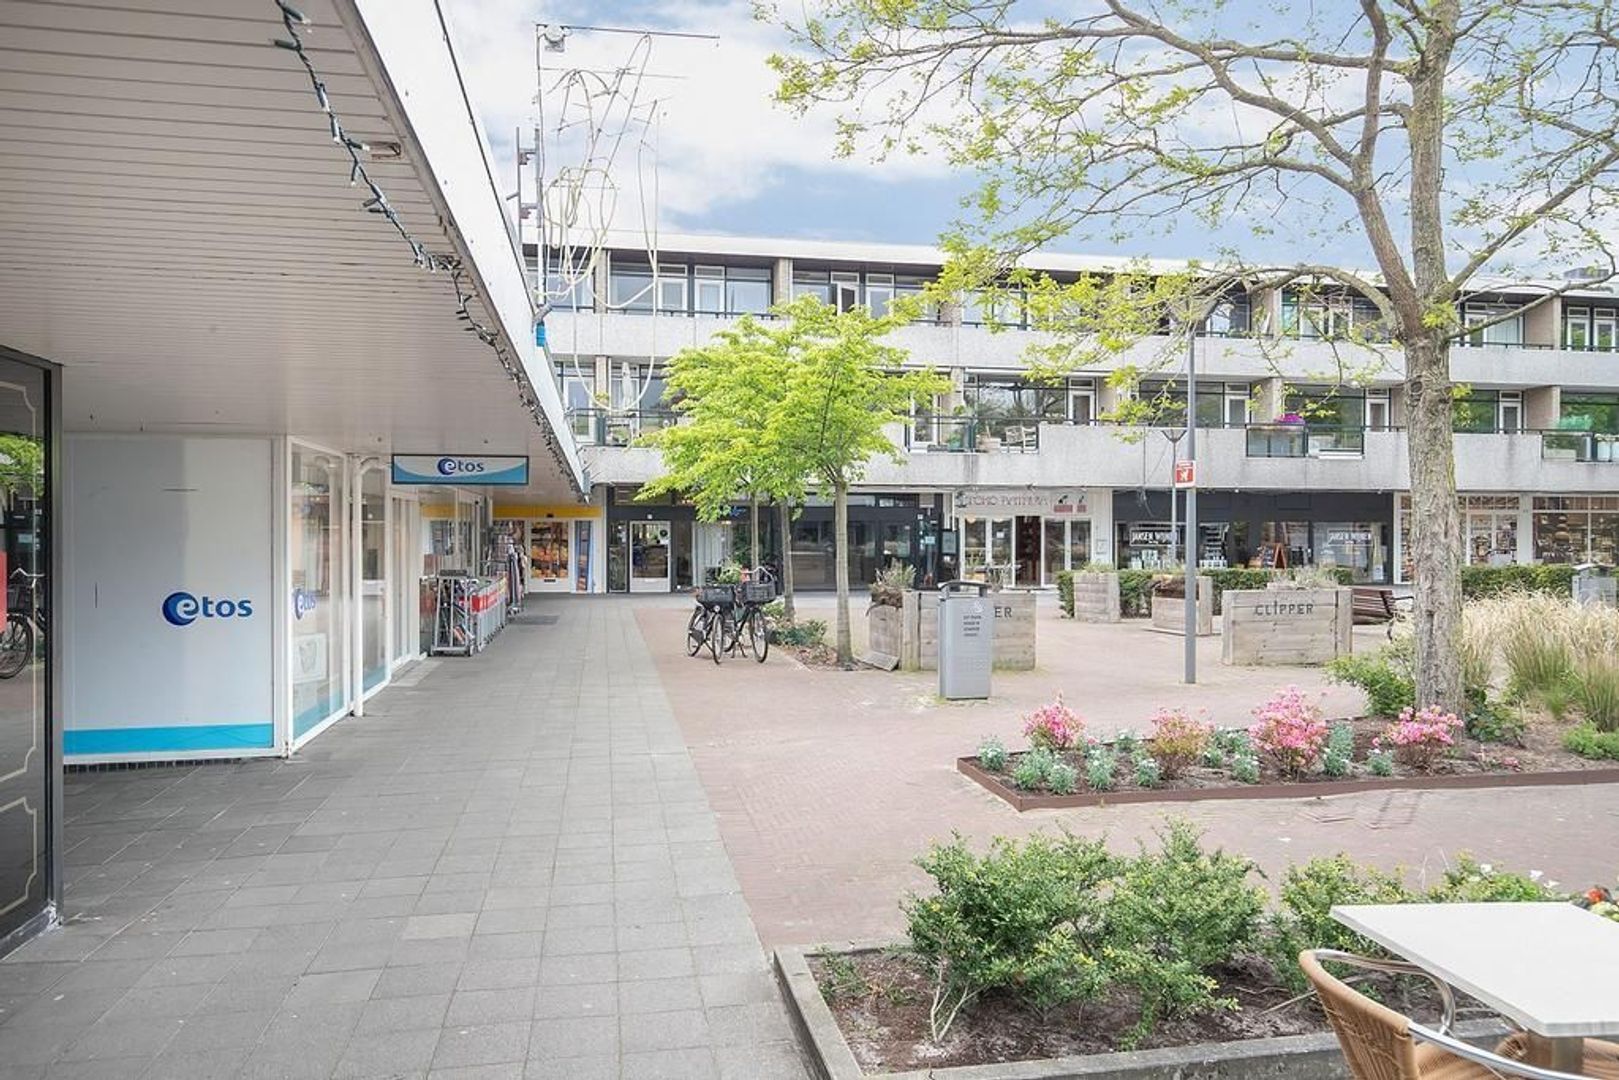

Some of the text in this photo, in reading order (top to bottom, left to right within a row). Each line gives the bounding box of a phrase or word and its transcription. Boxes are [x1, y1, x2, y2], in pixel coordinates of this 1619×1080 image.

[437, 458, 484, 475] etos
[162, 592, 253, 626] etos
[1255, 601, 1313, 615] CLIPPER
